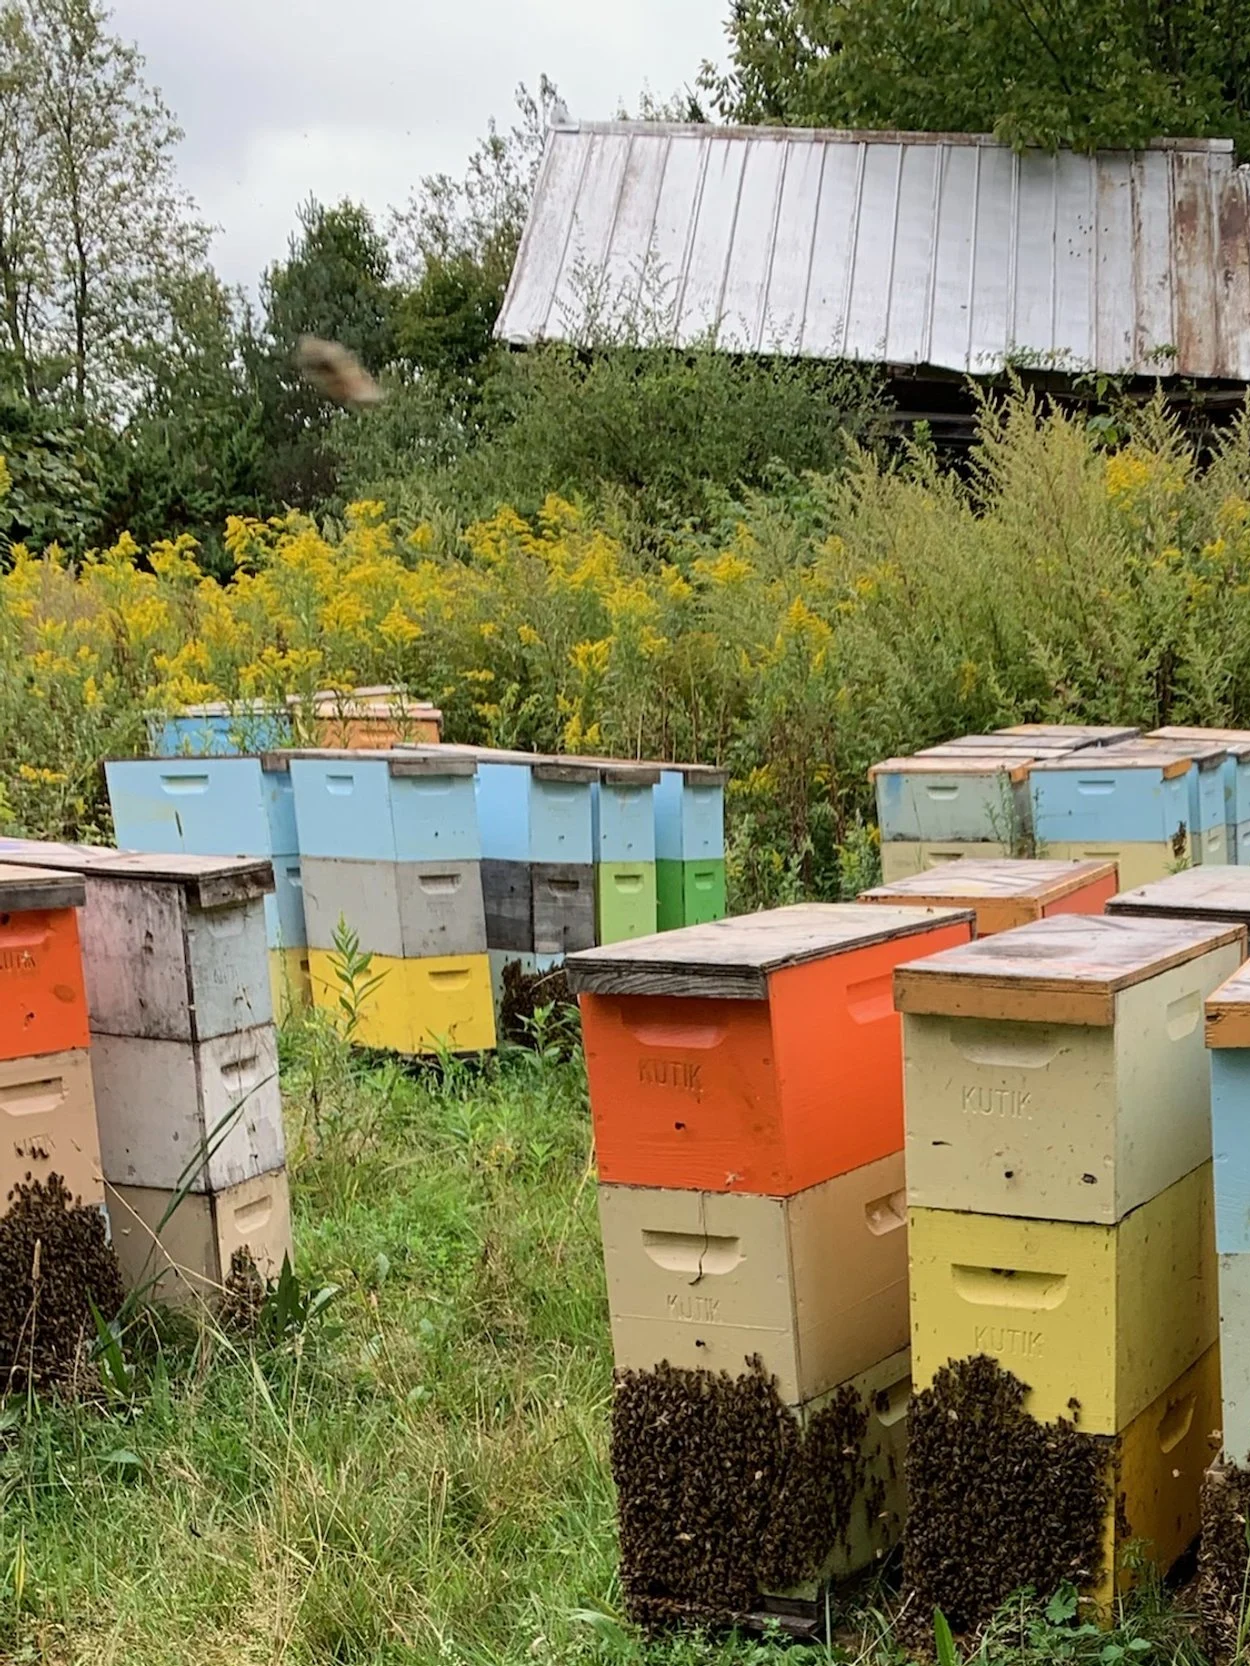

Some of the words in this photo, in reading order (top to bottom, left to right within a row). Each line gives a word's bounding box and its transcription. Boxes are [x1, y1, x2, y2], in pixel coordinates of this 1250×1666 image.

[638, 1058, 703, 1090] KUTIK
[962, 1085, 1033, 1120] KUTIK
[665, 1293, 720, 1324] KUTIK
[974, 1325, 1044, 1358] KUTIK
